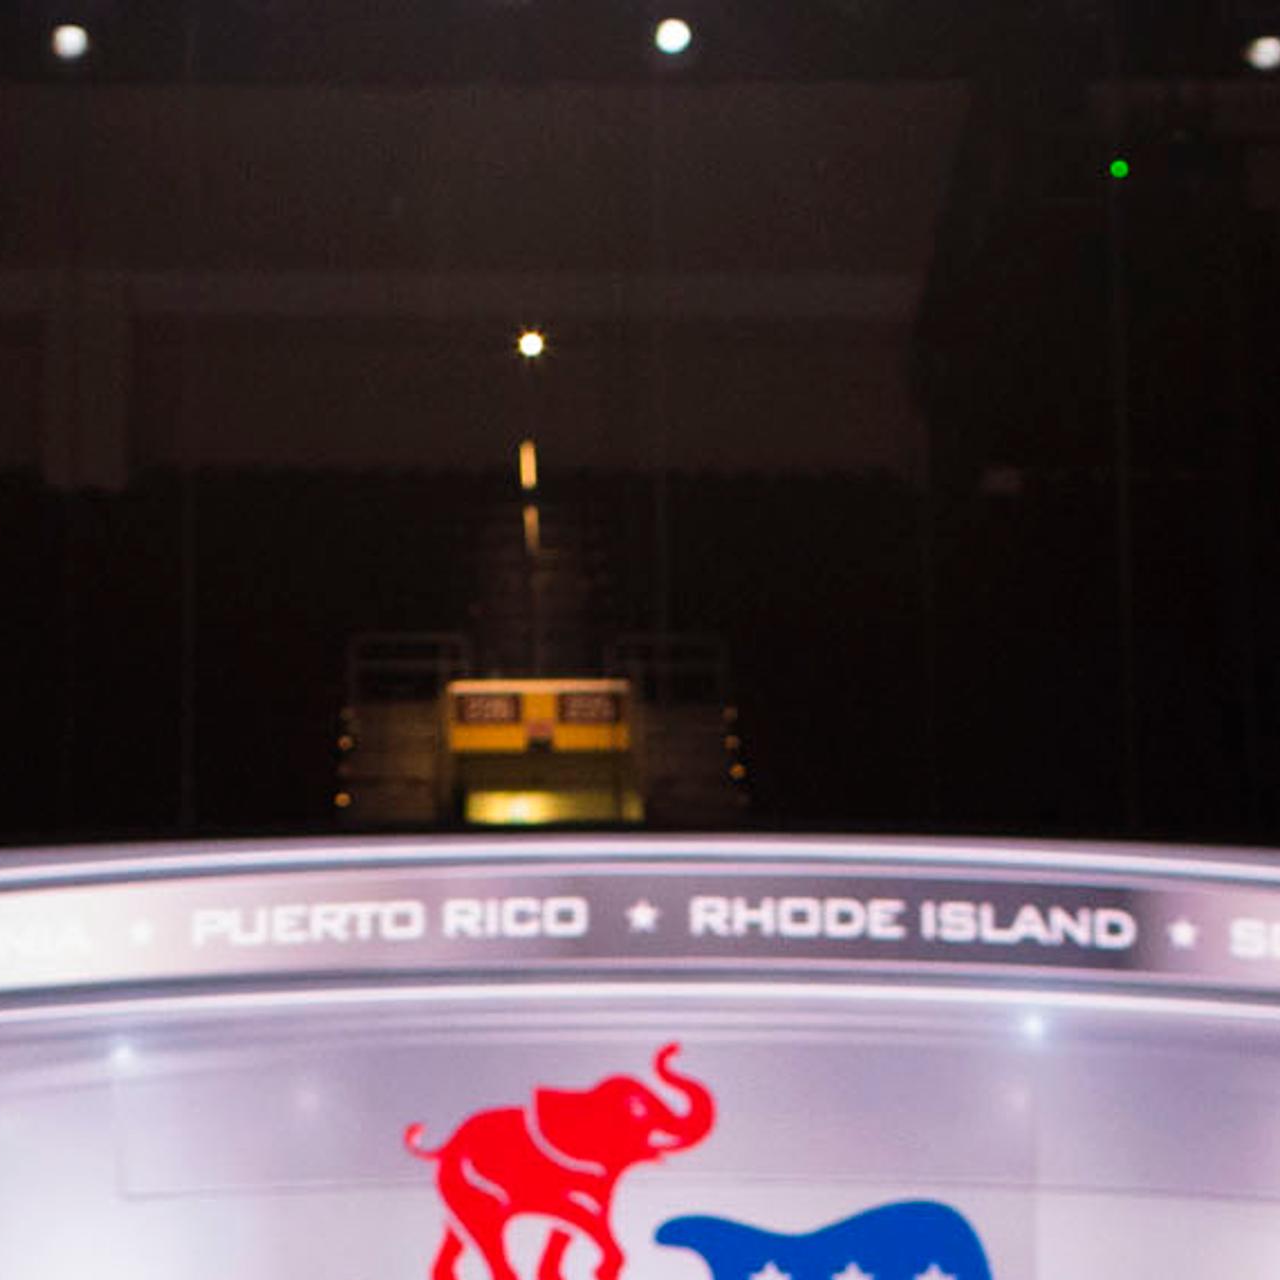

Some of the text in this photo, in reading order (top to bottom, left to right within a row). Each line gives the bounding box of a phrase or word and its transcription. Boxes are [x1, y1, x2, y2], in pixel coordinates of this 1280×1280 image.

[194, 896, 588, 945] PUERTO RICO
[689, 896, 1137, 950] RHODE ISLAND
